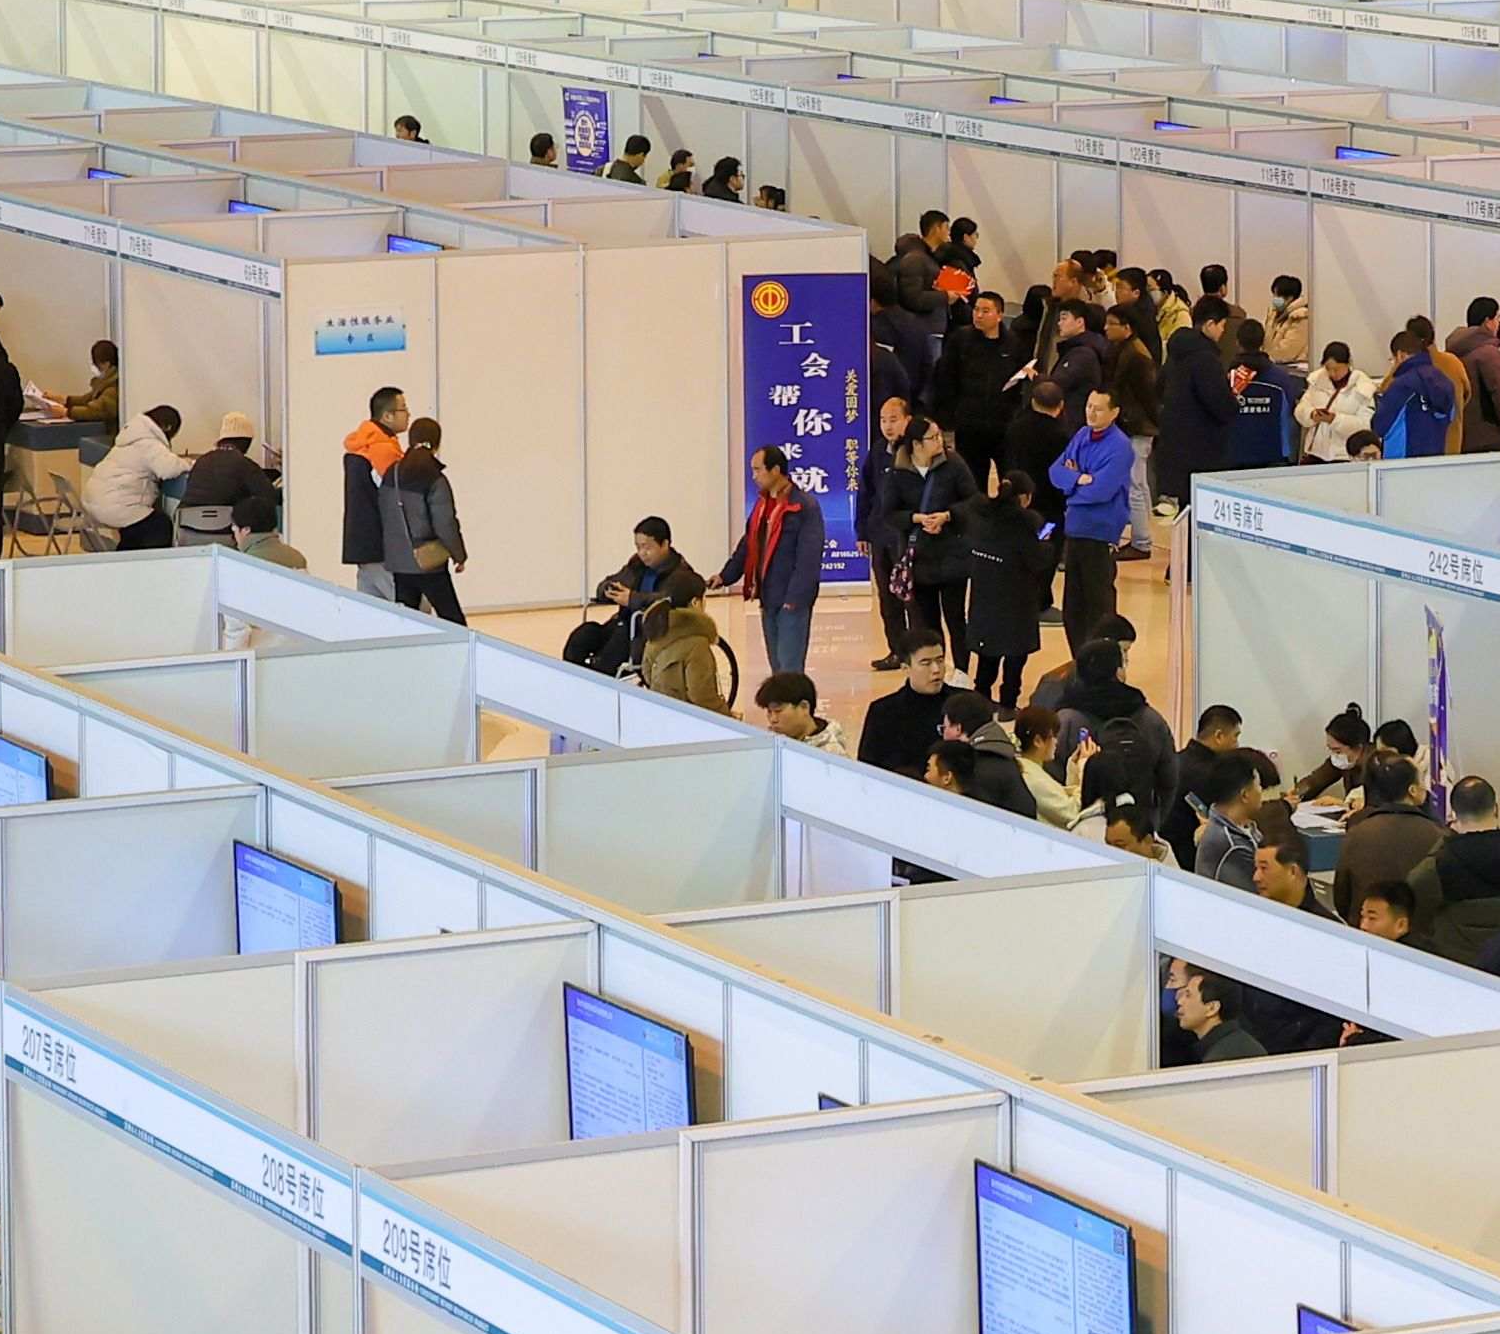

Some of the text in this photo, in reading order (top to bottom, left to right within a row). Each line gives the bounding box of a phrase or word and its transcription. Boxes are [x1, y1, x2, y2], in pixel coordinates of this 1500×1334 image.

[1214, 498, 1264, 533] 241号席位
[1428, 550, 1484, 585] 242号席位
[22, 1024, 78, 1085] 207号席位
[262, 1151, 325, 1221] 208号席位
[383, 1218, 452, 1291] 209号席位
